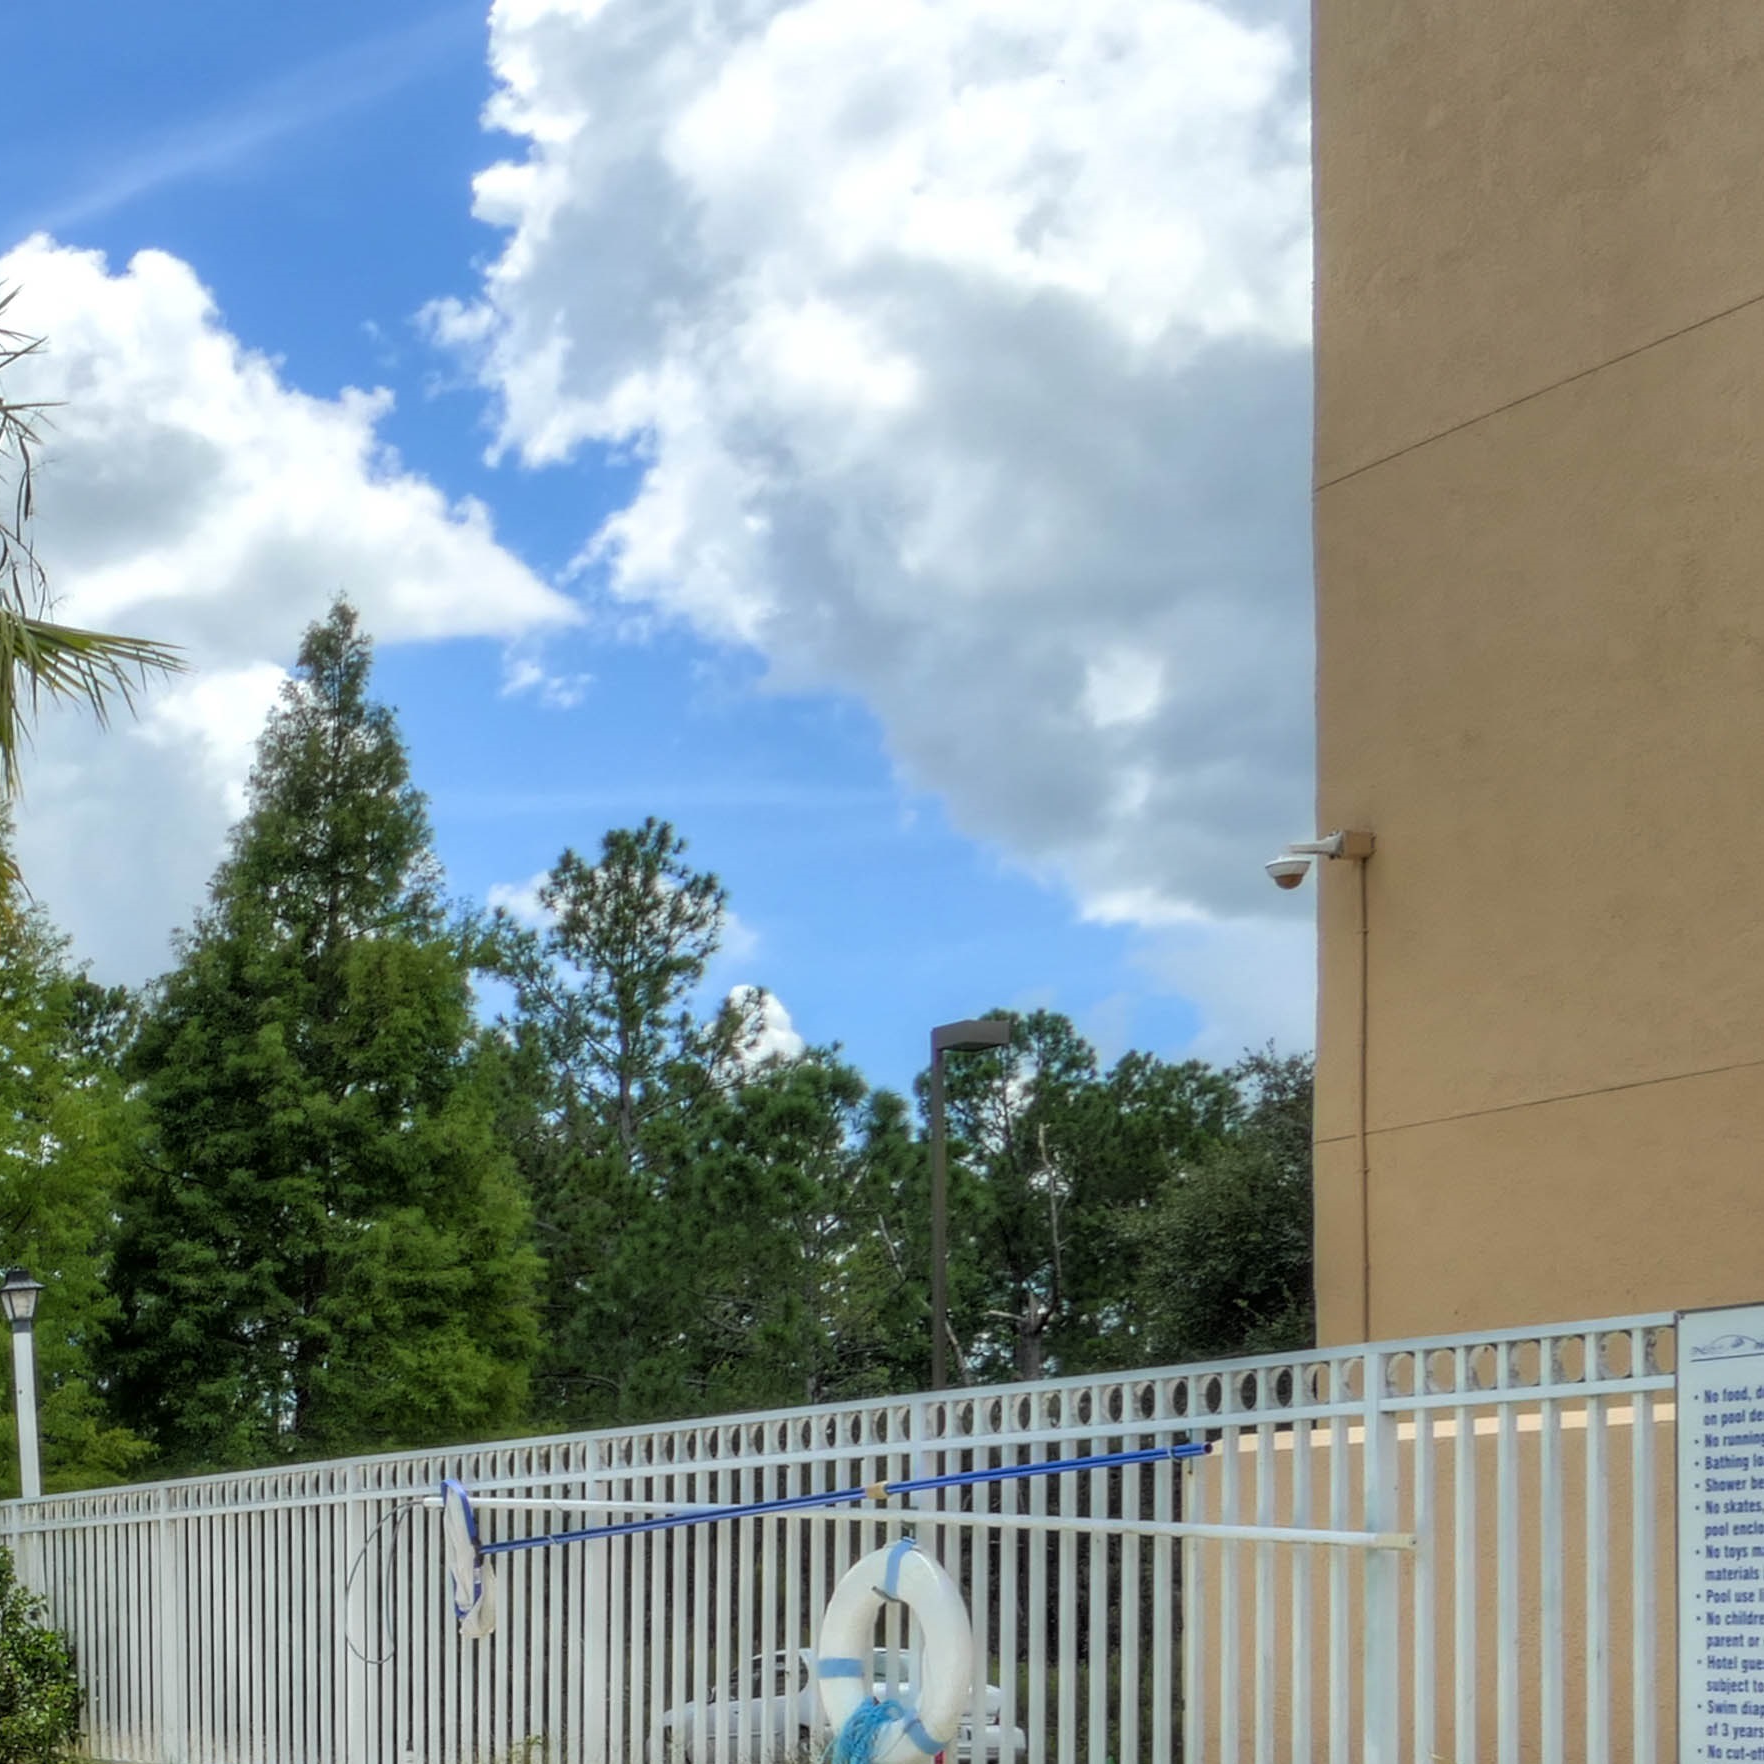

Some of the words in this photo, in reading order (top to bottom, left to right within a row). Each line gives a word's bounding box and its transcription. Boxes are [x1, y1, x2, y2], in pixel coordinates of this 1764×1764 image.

[1704, 1390, 1719, 1403] No
[1704, 1414, 1717, 1426] on
[1721, 1409, 1746, 1428] pool
[1705, 1433, 1719, 1448] No
[1705, 1454, 1749, 1471] Bathing
[1705, 1478, 1747, 1492] Shower
[1705, 1500, 1720, 1514] No
[1705, 1522, 1729, 1540] pool
[1705, 1545, 1720, 1559] No
[1724, 1545, 1749, 1561] toys
[1705, 1566, 1760, 1581] materials
[1705, 1588, 1731, 1603] Pool
[1734, 1591, 1755, 1603] use
[1706, 1612, 1721, 1626] No
[1706, 1634, 1744, 1650] parent
[1748, 1636, 1760, 1647] or
[1707, 1655, 1738, 1670] Hotel
[1706, 1678, 1749, 1695] subject
[1752, 1679, 1764, 1693] to
[1707, 1700, 1738, 1714] Swim
[1706, 1722, 1718, 1737] of
[1721, 1722, 1729, 1737] 3
[1707, 1744, 1722, 1759] No
